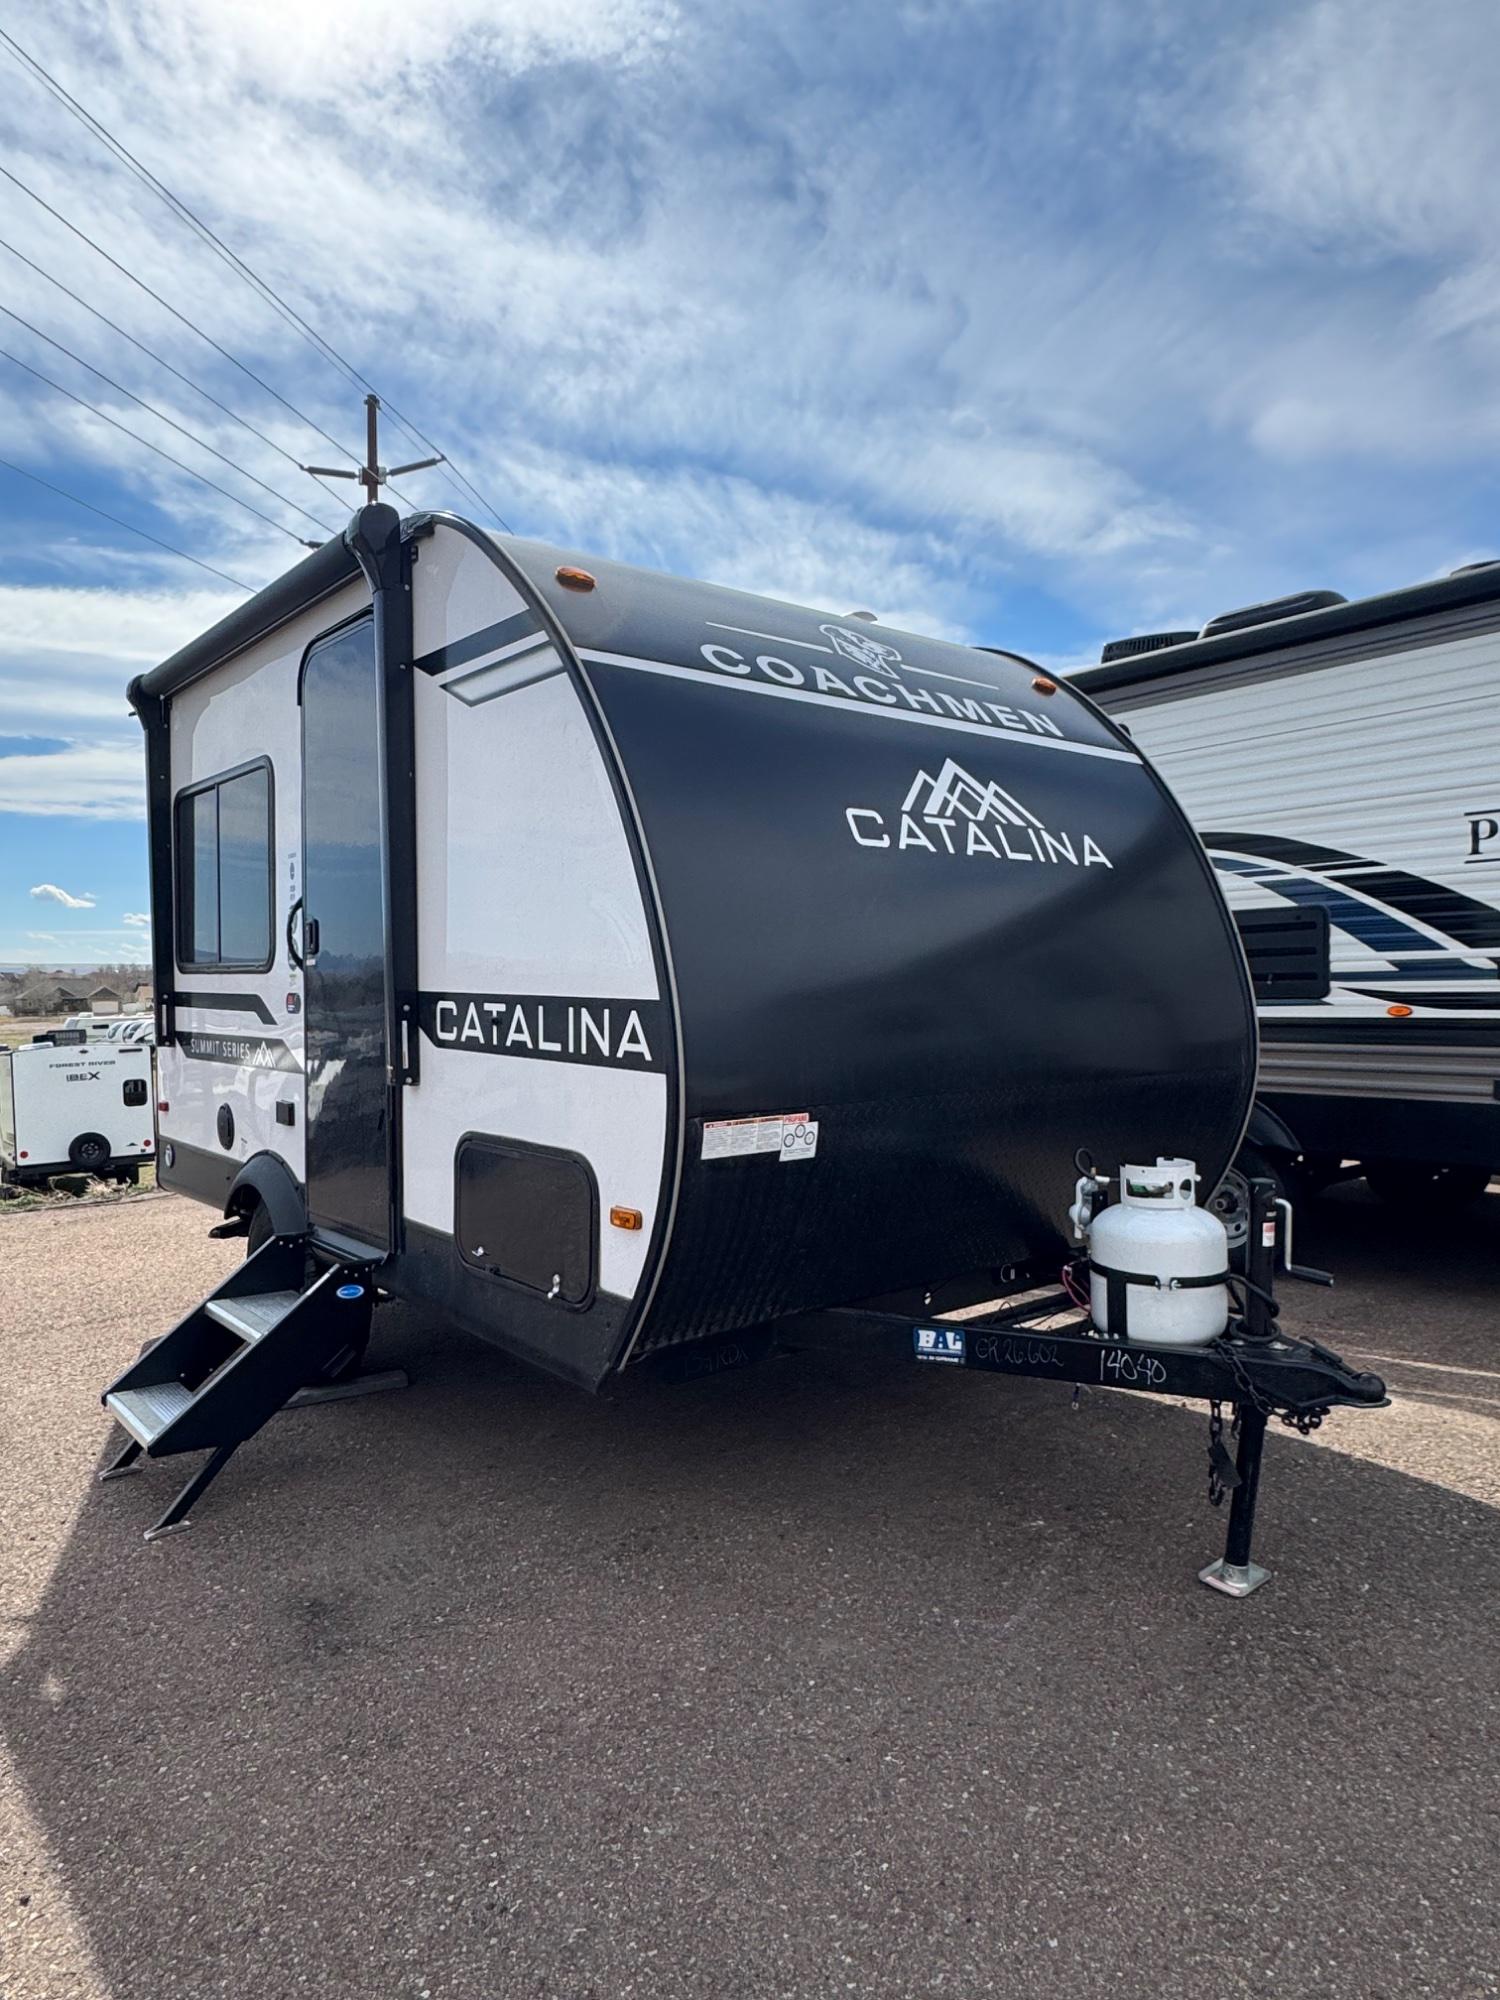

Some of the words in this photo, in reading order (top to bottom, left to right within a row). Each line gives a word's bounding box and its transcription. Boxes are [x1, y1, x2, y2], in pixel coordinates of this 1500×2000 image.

[699, 643, 1065, 738] COACHMEN
[845, 806, 1113, 869] CATALINA
[191, 1038, 219, 1056] SUMMIT
[222, 1041, 250, 1059] SERIES
[436, 1000, 653, 1061] CATALINA
